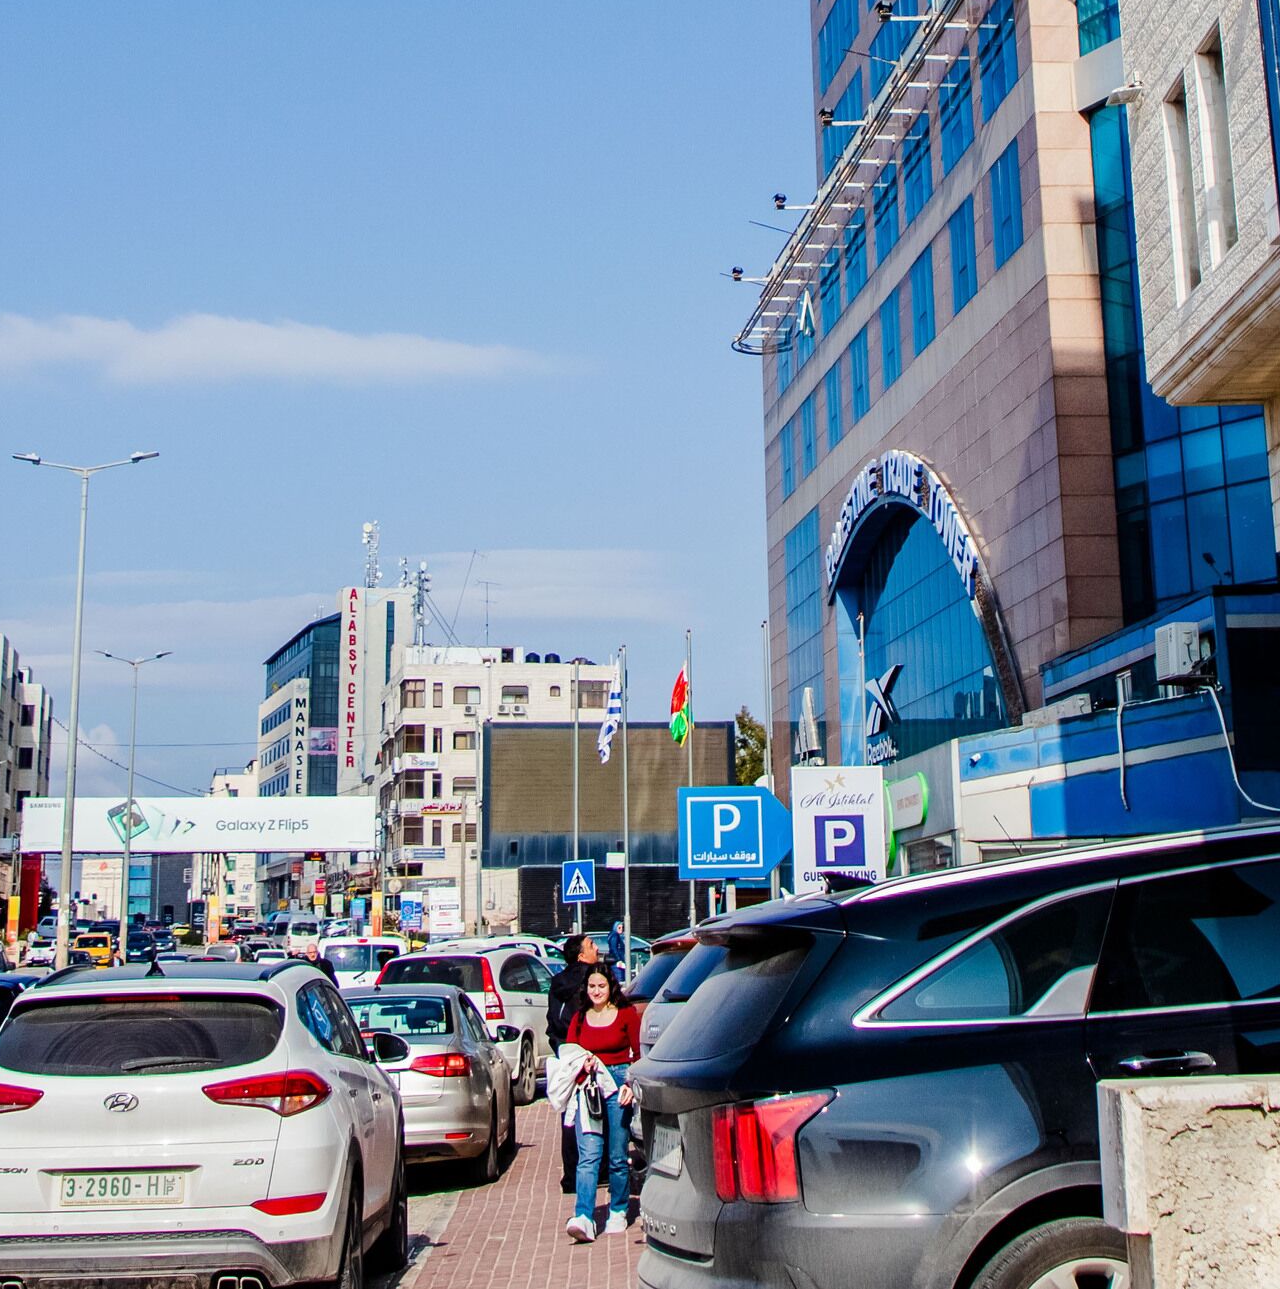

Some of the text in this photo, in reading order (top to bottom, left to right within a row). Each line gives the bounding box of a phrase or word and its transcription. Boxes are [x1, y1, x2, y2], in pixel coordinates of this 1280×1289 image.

[880, 449, 923, 507] TRADE
[928, 470, 978, 601] TOWER
[345, 588, 358, 768] AL-ABSY CENTER
[800, 791, 825, 809] Al
[826, 791, 874, 809] Istiklal
[215, 818, 309, 833] Galaxy Z Flip5
[713, 803, 741, 849] P
[825, 820, 856, 862] P
[693, 850, 757, 863] موقف سيارات
[837, 870, 877, 881] RKING
